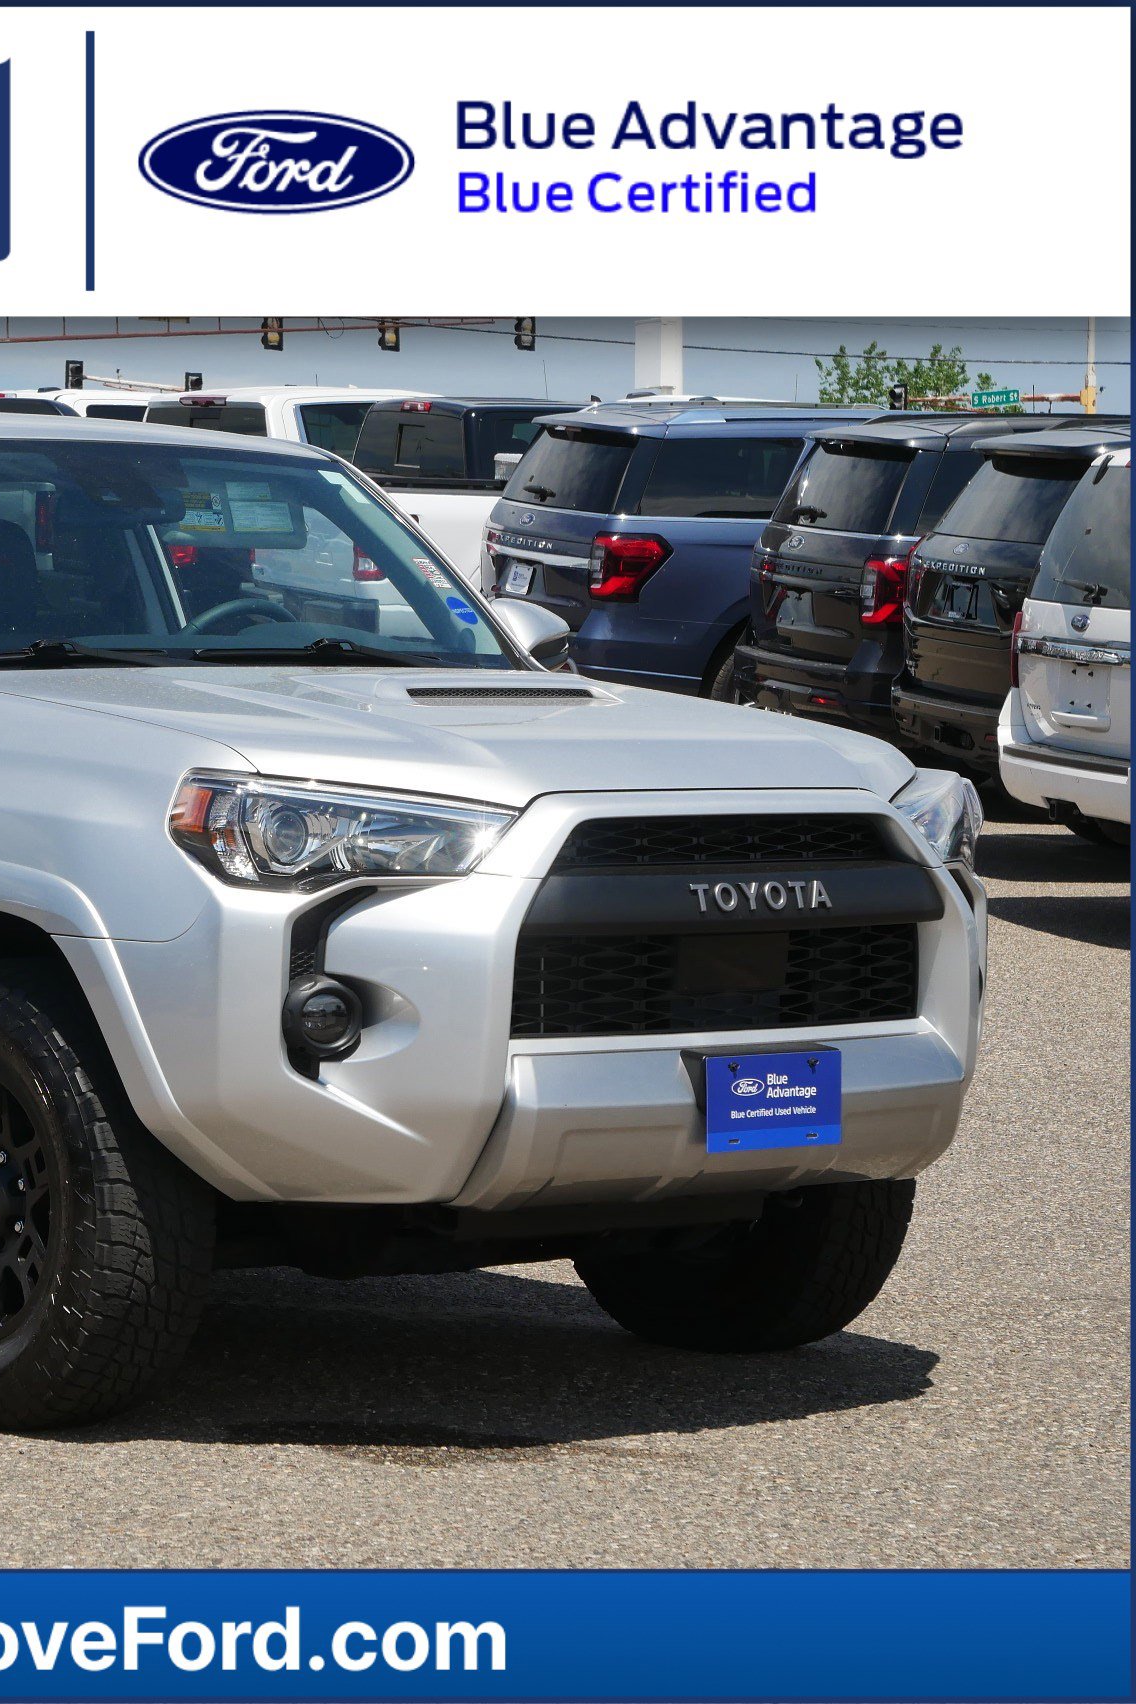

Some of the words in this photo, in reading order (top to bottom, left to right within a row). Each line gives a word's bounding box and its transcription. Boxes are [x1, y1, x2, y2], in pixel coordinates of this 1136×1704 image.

[974, 395, 979, 404] S
[982, 394, 1006, 404] Robert
[1009, 392, 1017, 401] St
[495, 533, 553, 550] EXPEDITION
[925, 560, 986, 576] EXPEDITION
[689, 880, 833, 912] TOYOTA
[737, 1081, 758, 1093] Ford
[766, 1073, 788, 1085] Blue
[766, 1085, 817, 1098] Advantage
[730, 1110, 745, 1119] Blue
[746, 1108, 773, 1118] Certified
[775, 1106, 791, 1116] Used
[793, 1105, 816, 1115] Vehicle
